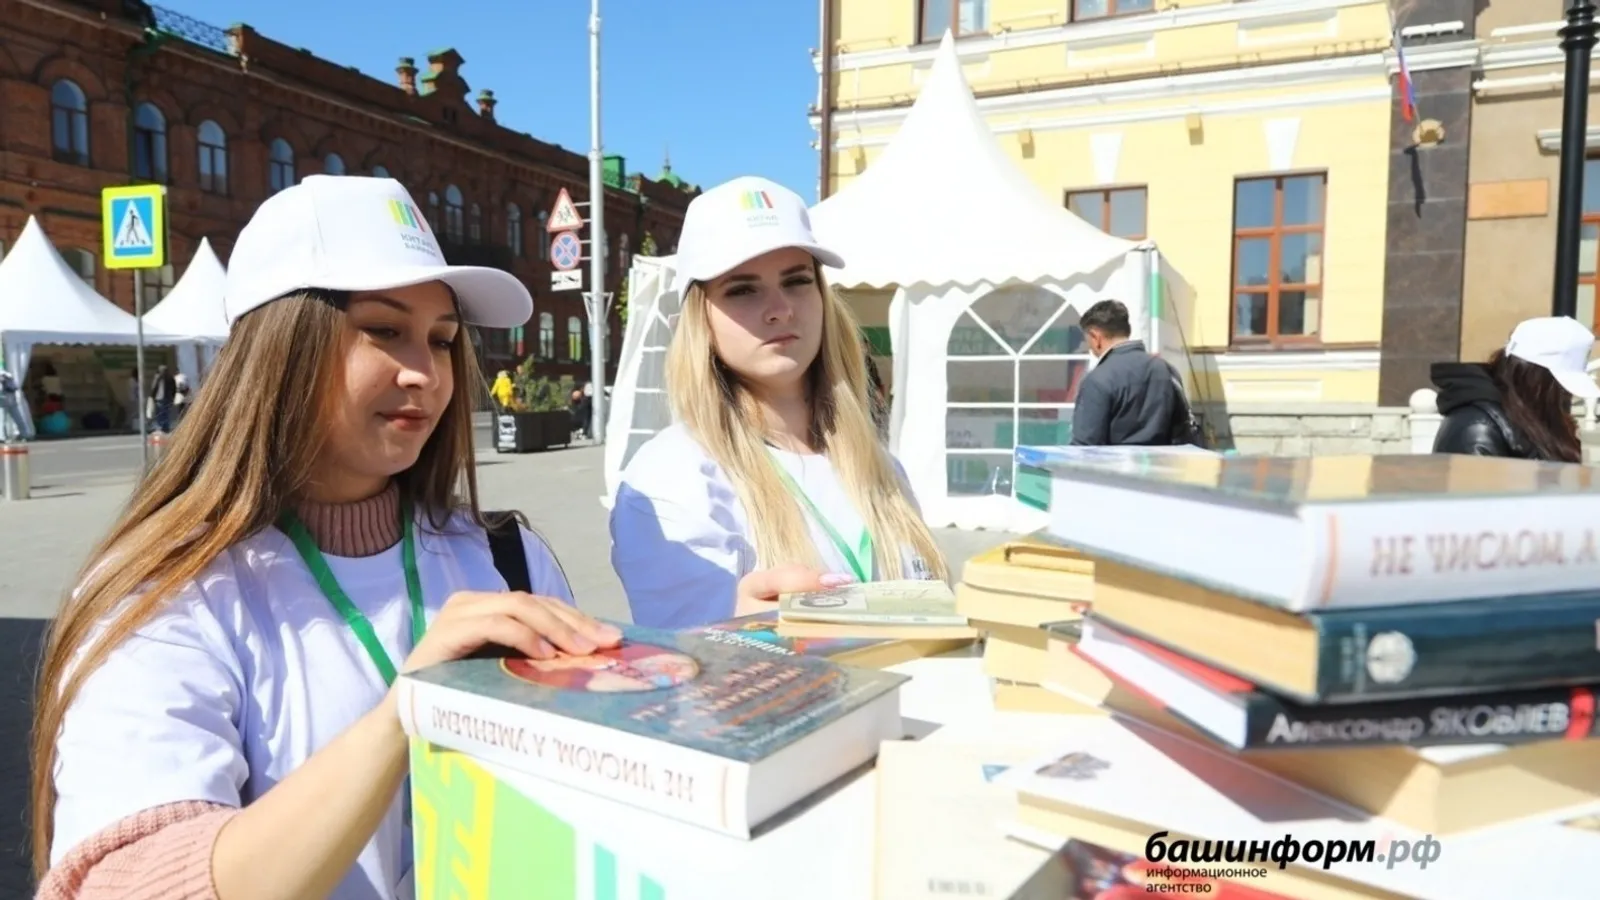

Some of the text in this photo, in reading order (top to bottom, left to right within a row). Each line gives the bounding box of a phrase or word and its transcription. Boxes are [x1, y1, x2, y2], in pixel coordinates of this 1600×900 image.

[1370, 534, 1415, 577] НЕ
[533, 732, 547, 758] А
[664, 768, 695, 803] НЕ
